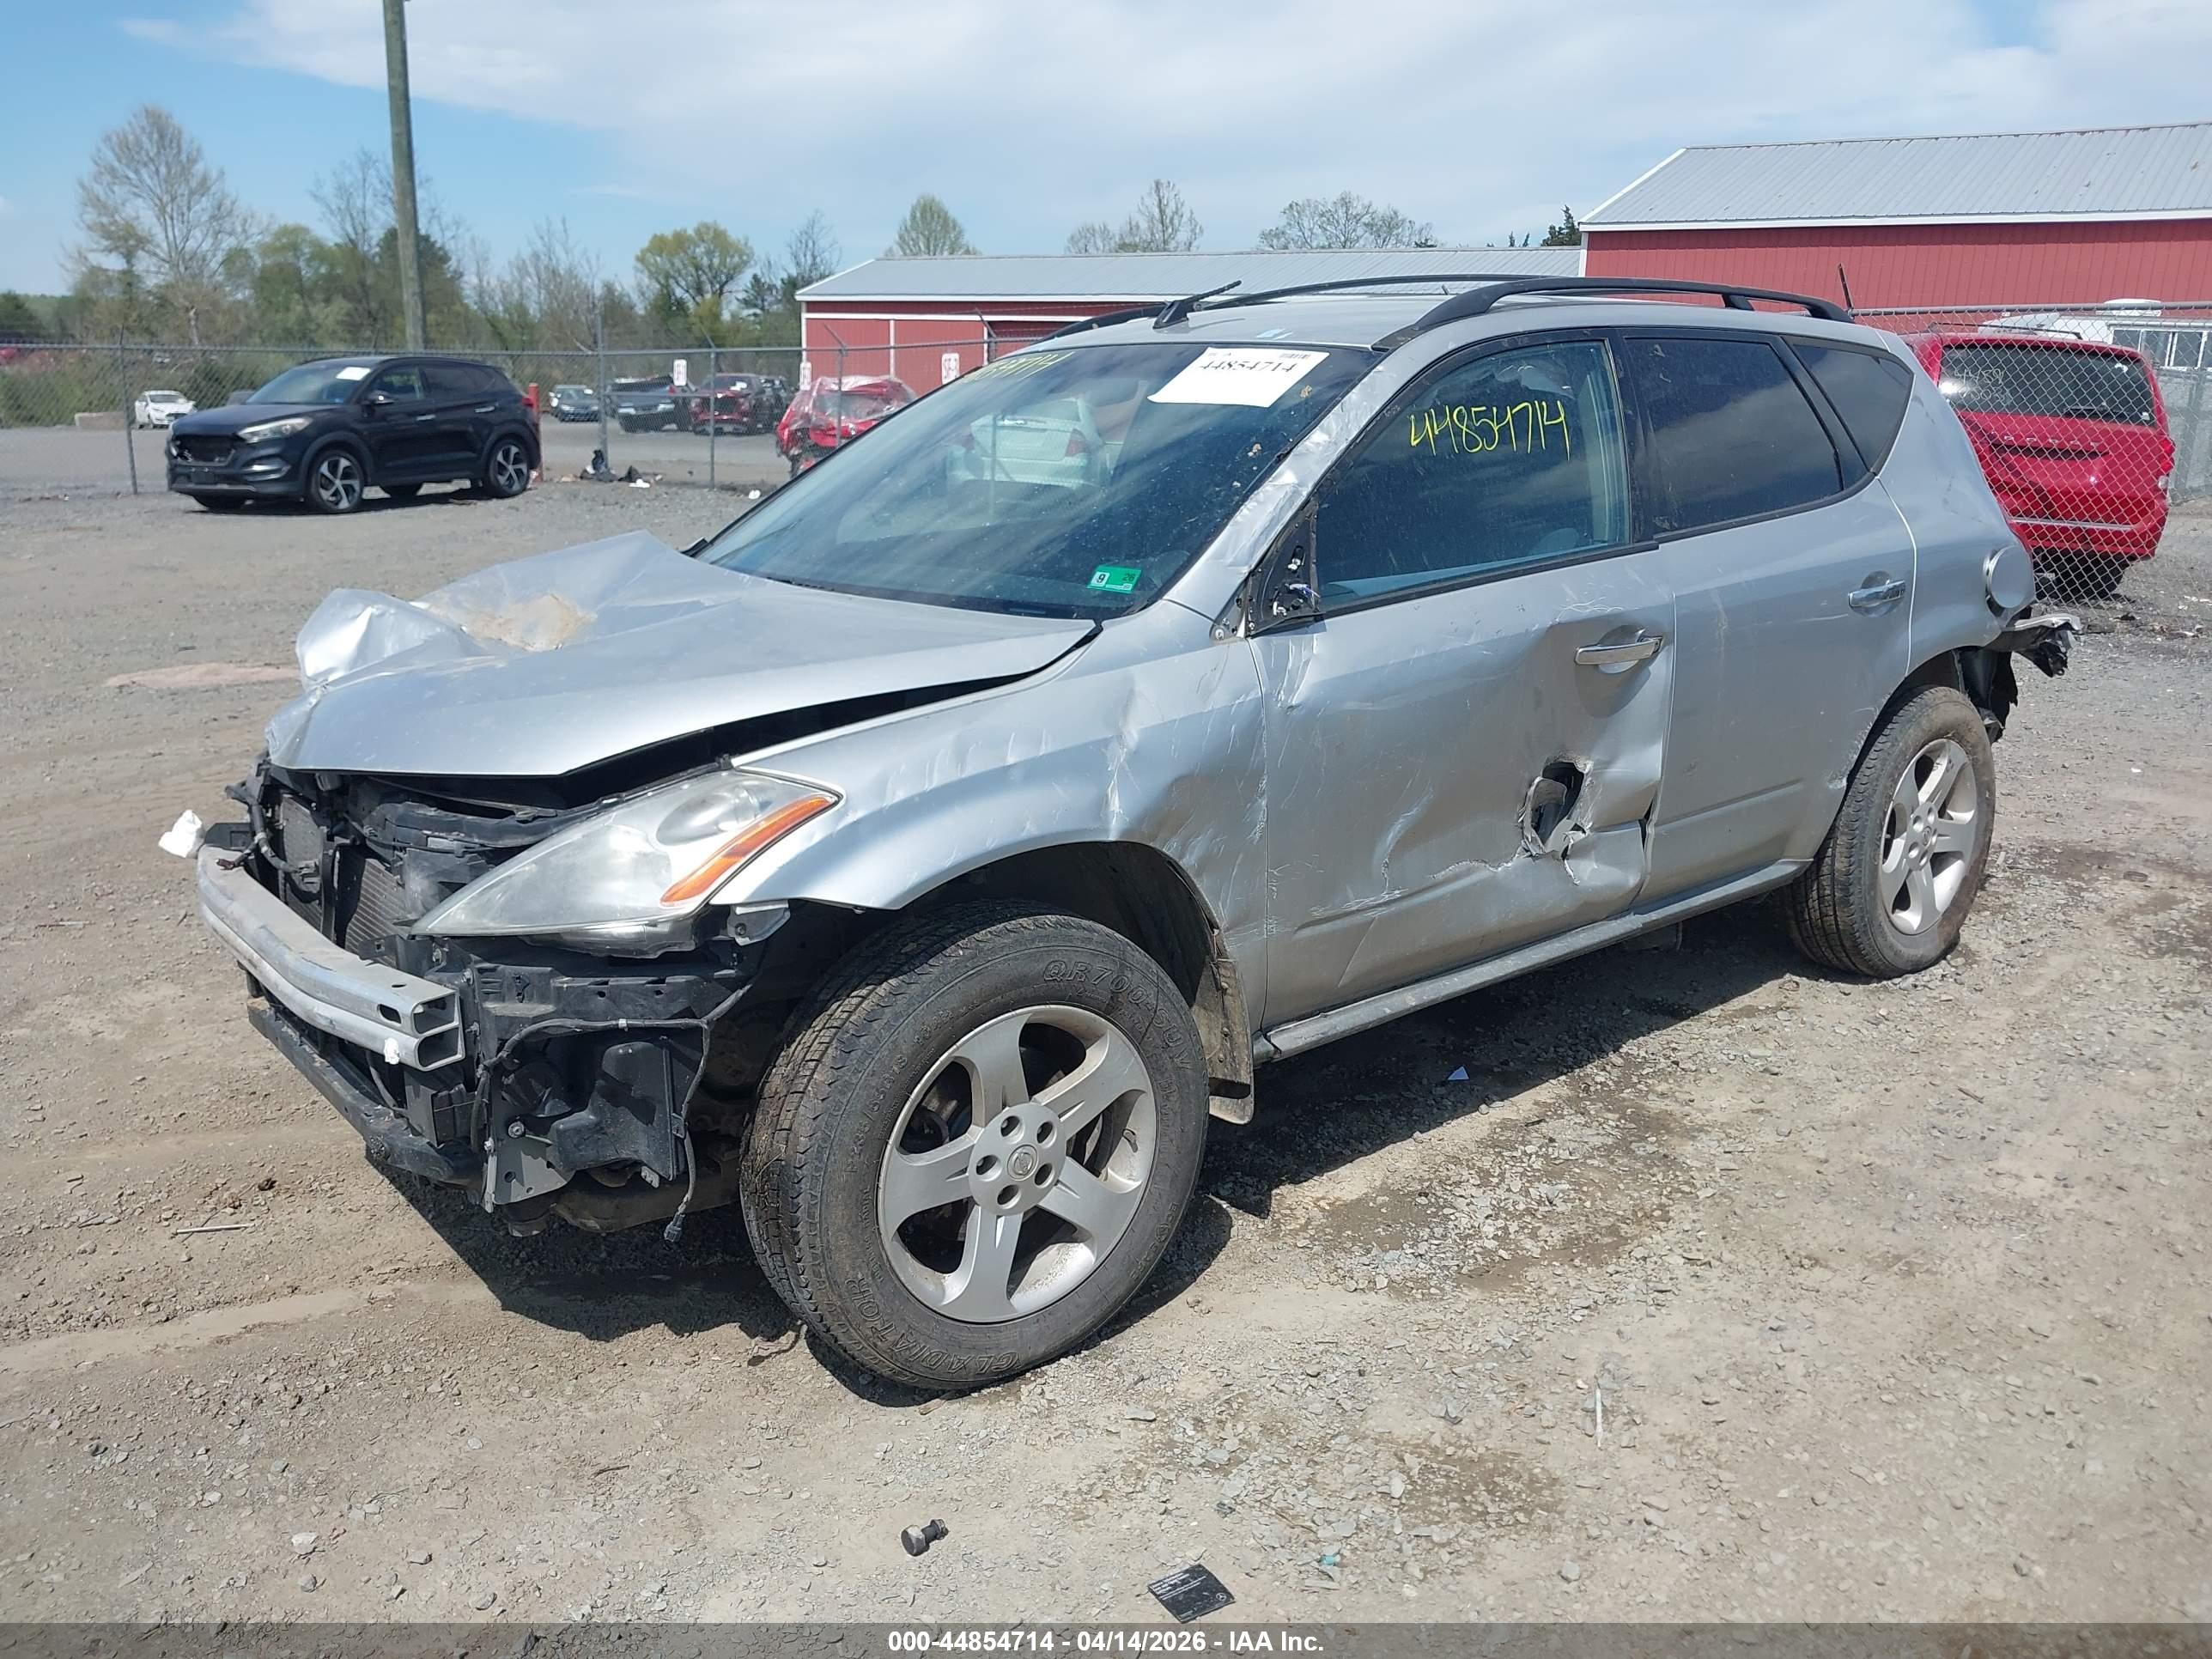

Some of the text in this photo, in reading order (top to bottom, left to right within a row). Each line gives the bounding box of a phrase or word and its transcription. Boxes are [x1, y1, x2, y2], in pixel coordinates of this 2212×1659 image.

[1198, 361, 1299, 373] 44854714
[1407, 399, 1571, 463] 44854714
[1096, 573, 1107, 584] 9
[1121, 573, 1137, 583] 26
[845, 1270, 1020, 1377] GLADIATOR
